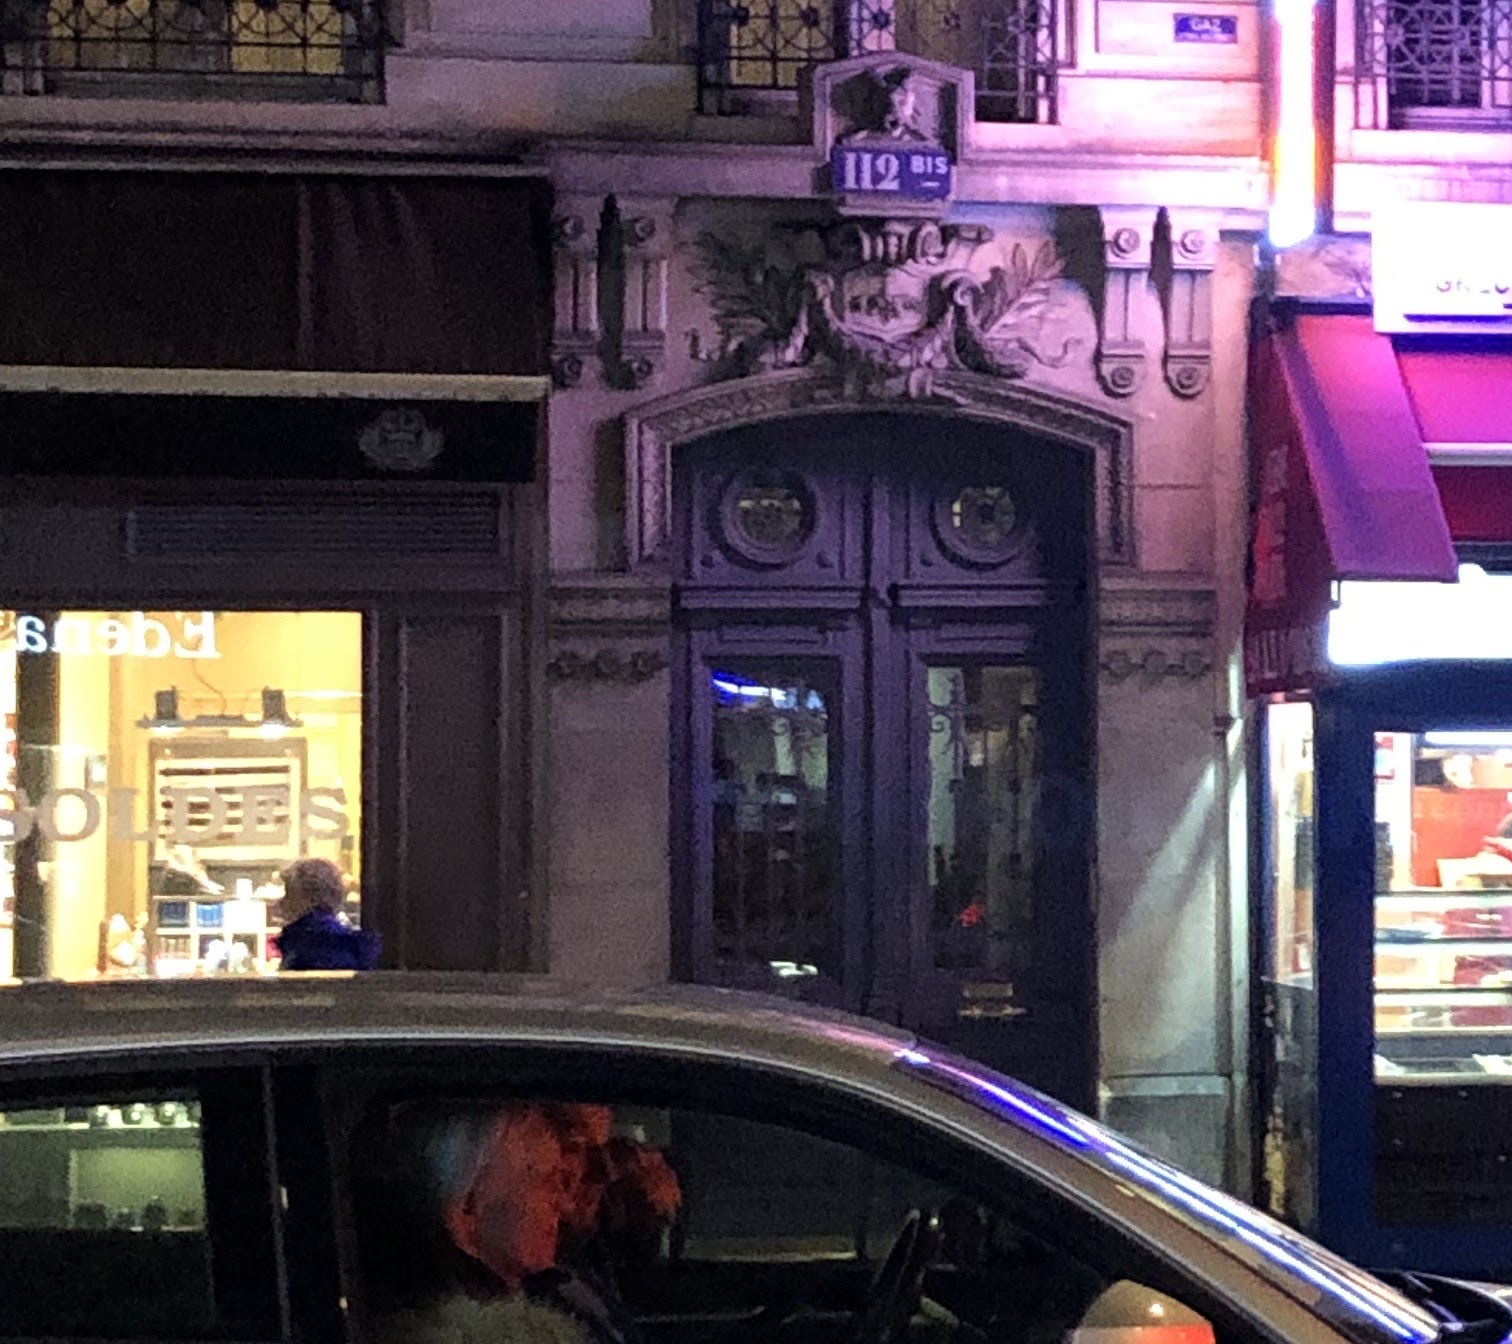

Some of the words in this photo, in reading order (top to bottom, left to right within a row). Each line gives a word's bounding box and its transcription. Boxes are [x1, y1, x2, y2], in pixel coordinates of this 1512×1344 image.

[843, 151, 900, 190] 112
[909, 154, 949, 175] BIS
[0, 786, 350, 847] SOLDES
